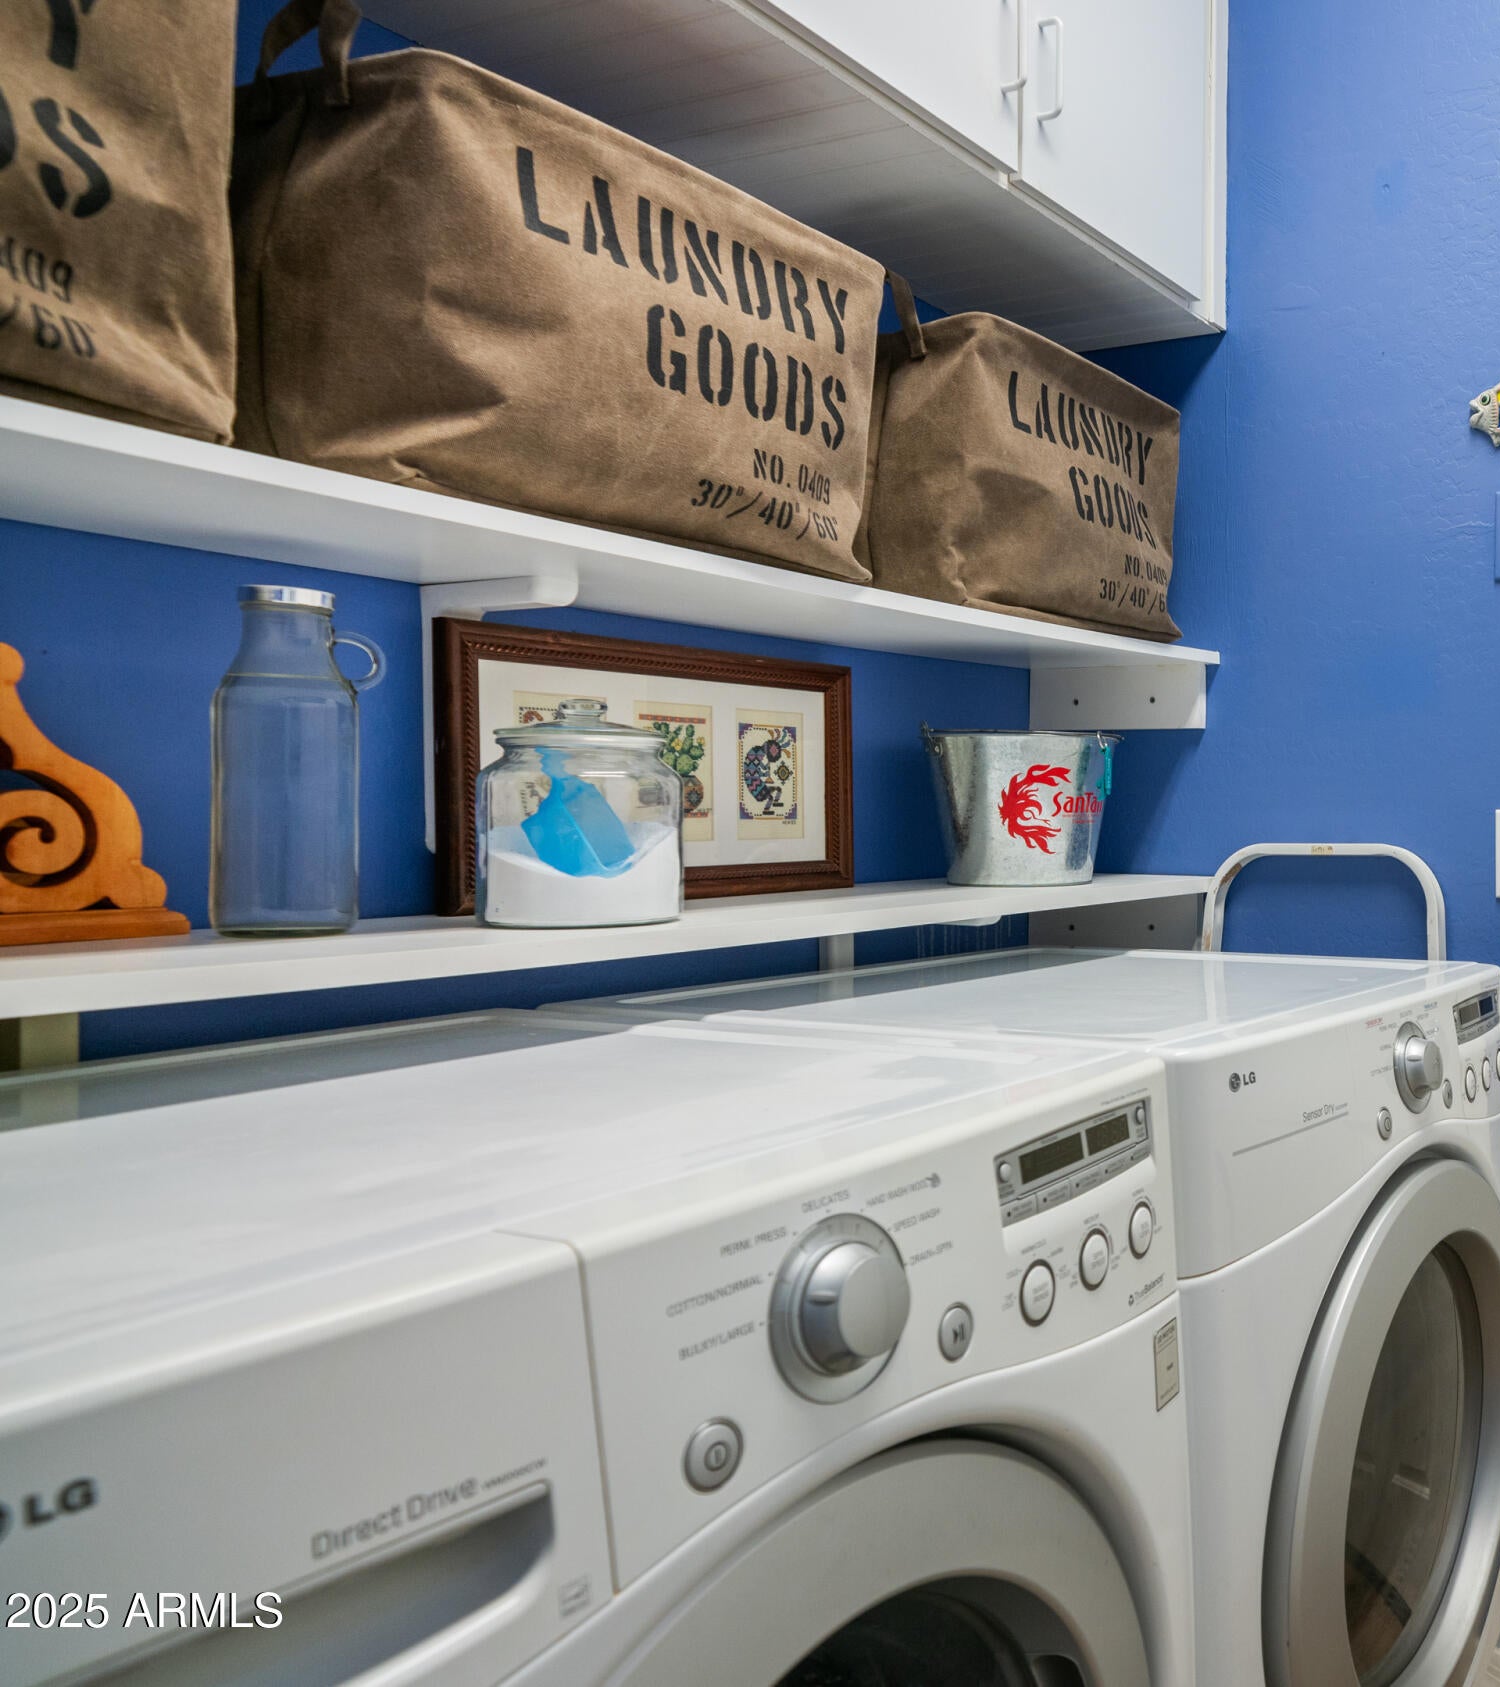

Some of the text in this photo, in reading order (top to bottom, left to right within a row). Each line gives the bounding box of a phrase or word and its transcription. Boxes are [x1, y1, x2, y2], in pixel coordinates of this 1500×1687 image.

[0, 237, 72, 303] 409
[516, 146, 849, 355] LAUNDRY
[646, 303, 847, 452] GOODS
[1007, 370, 1153, 486] LAUNDRY
[753, 448, 831, 505] NO. 0409
[1068, 466, 1157, 550] GOODS
[1125, 554, 1144, 579] NO.
[1302, 1106, 1324, 1123] Sensor
[22, 1478, 97, 1528] LG
[310, 1476, 479, 1561] Direct Drive
